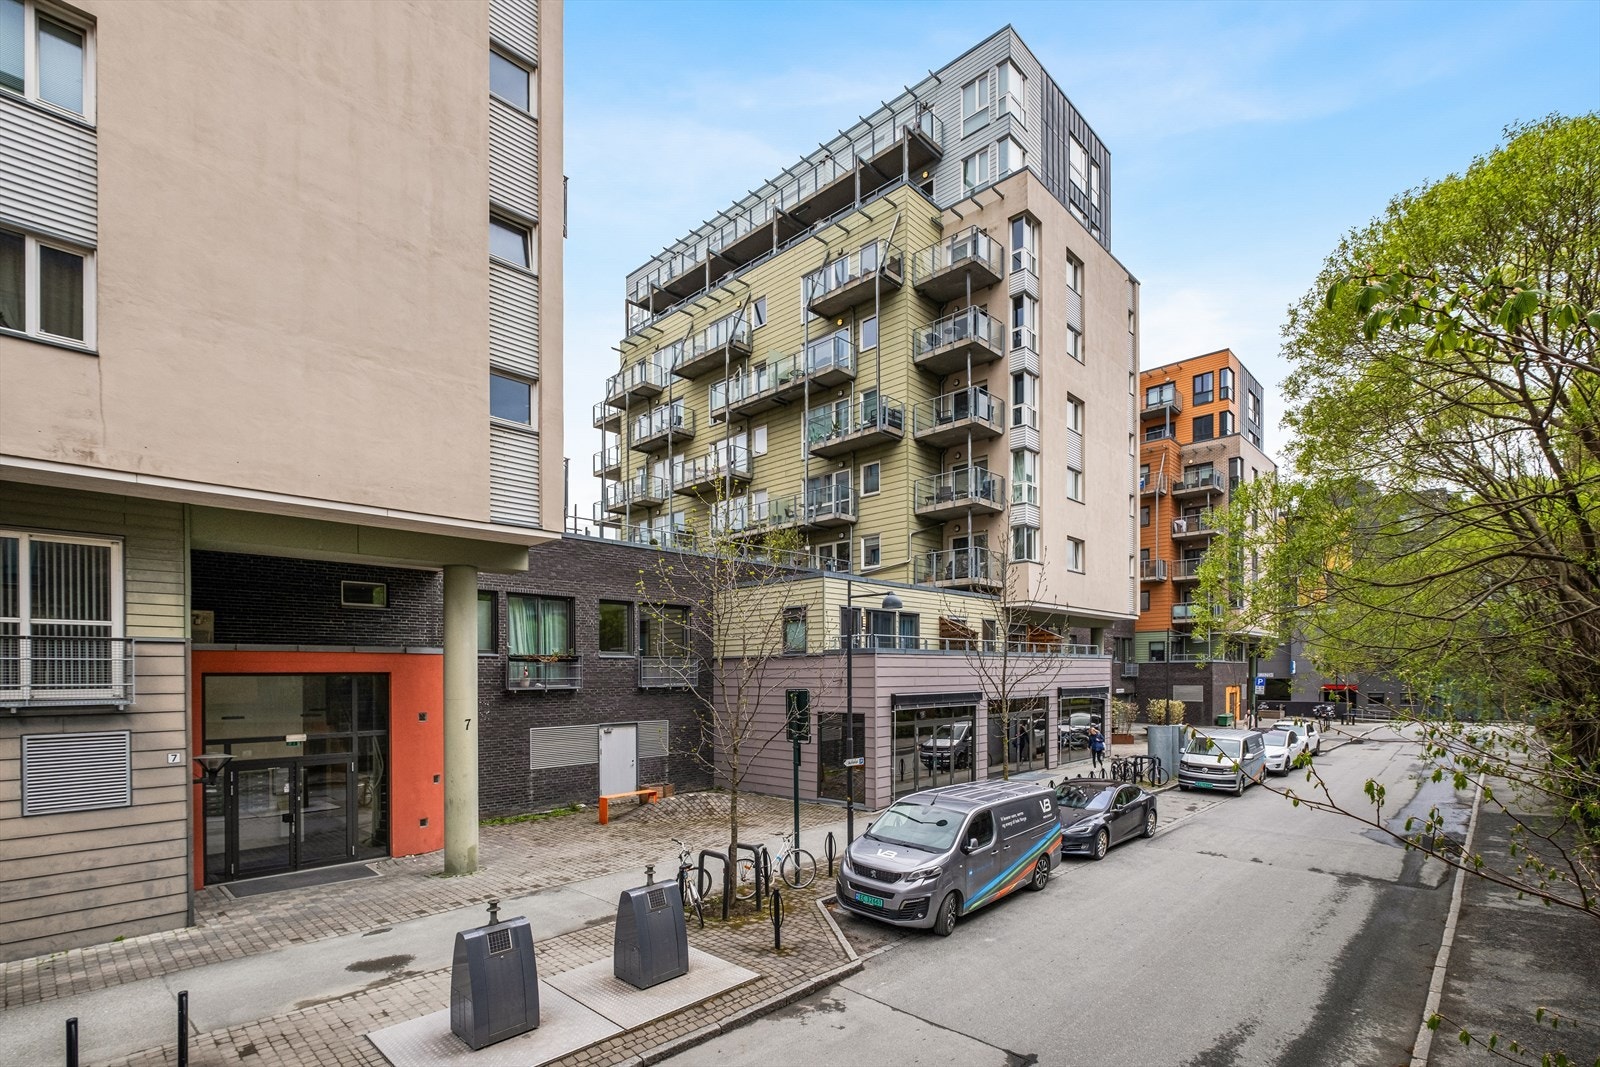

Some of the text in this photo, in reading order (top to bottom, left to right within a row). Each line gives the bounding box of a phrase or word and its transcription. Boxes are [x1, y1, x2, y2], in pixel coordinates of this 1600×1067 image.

[464, 718, 472, 731] 7
[170, 754, 178, 762] 7
[1039, 798, 1052, 813] VB
[876, 848, 898, 858] VB
